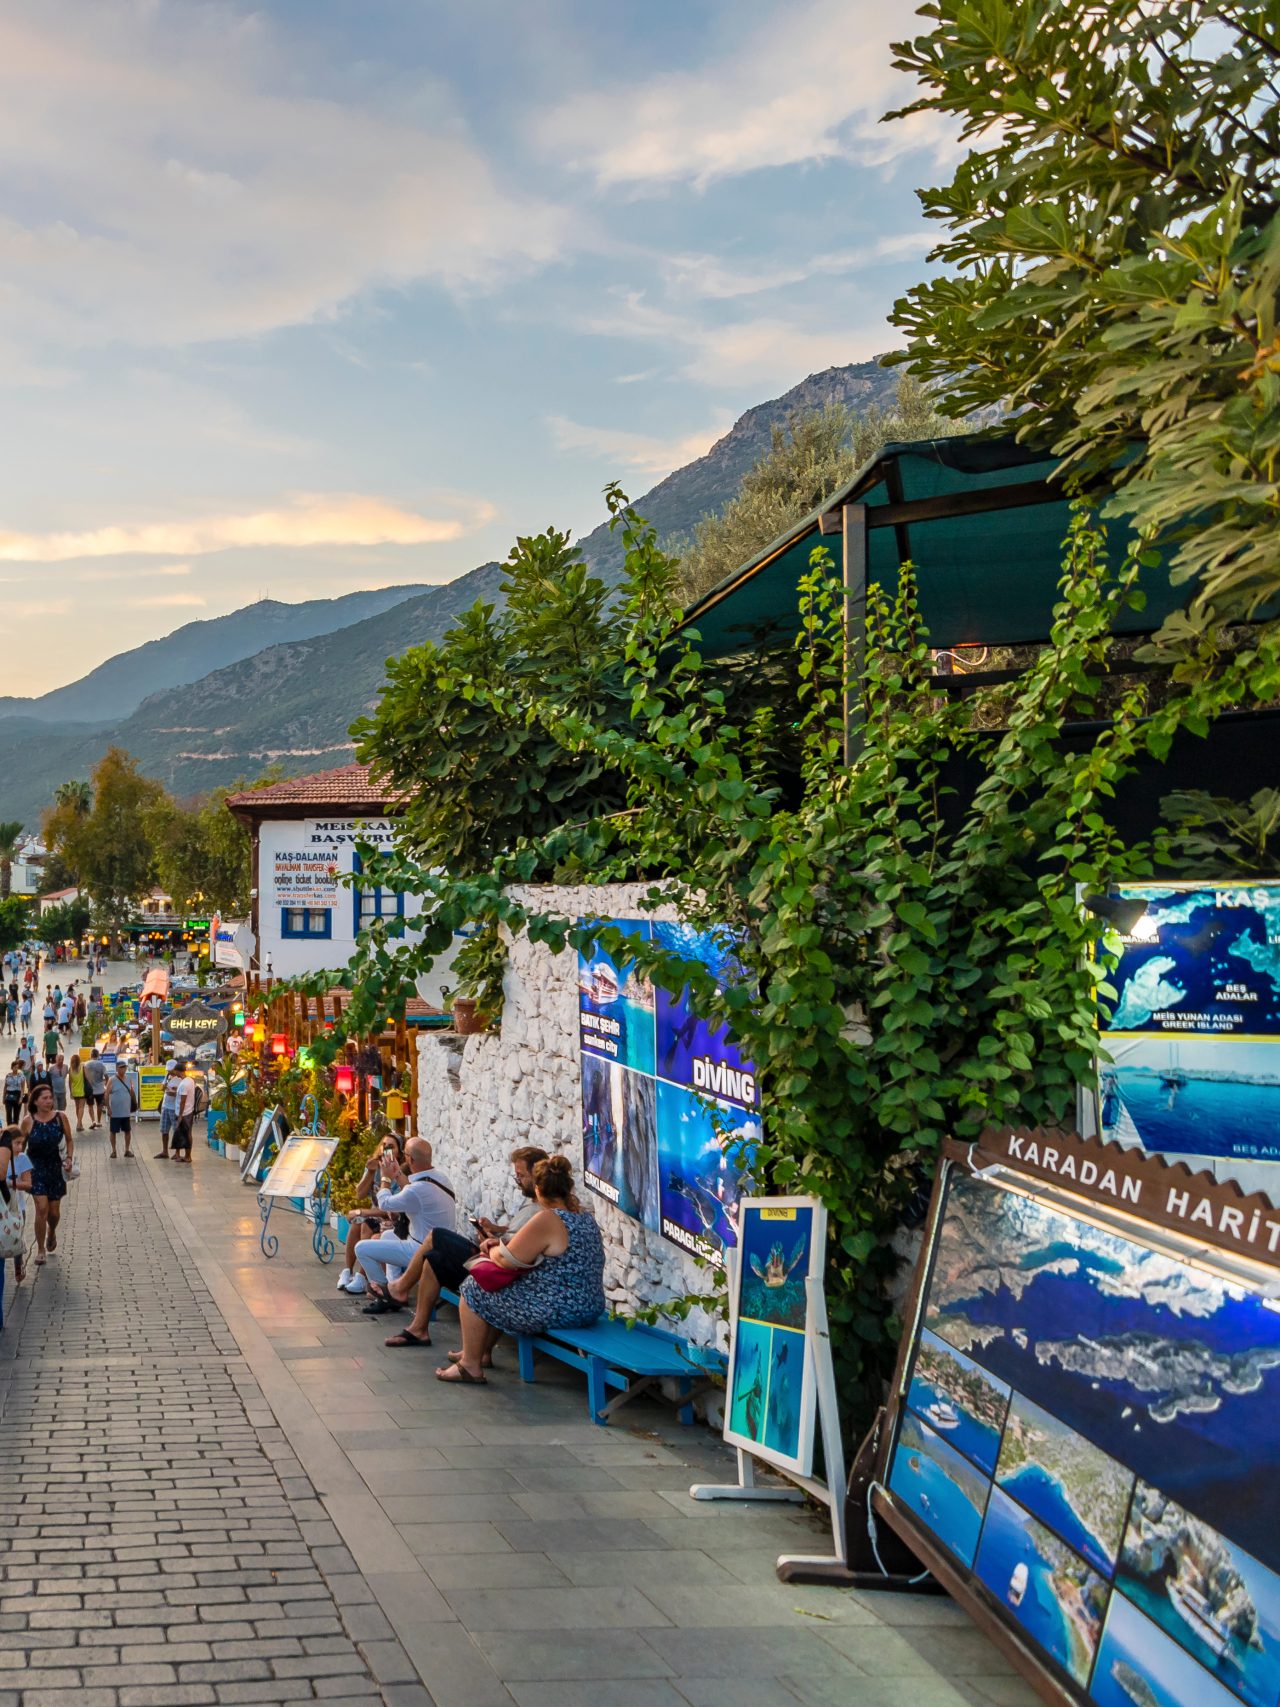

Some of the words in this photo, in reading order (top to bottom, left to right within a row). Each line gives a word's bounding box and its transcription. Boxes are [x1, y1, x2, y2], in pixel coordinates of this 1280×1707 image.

[275, 852, 338, 864] KAŞ-DALAMAN
[1215, 889, 1269, 910] KAŞ
[1225, 984, 1247, 994] BEŞ
[1215, 992, 1258, 1001] ADALAR
[1176, 1013, 1211, 1022] YUNAN
[194, 1018, 218, 1029] KEYF
[1161, 1020, 1195, 1029] GREEK
[1197, 1021, 1234, 1030] ISLAND
[693, 1054, 755, 1104] DİVİNG
[1007, 1134, 1142, 1204] KARADAN
